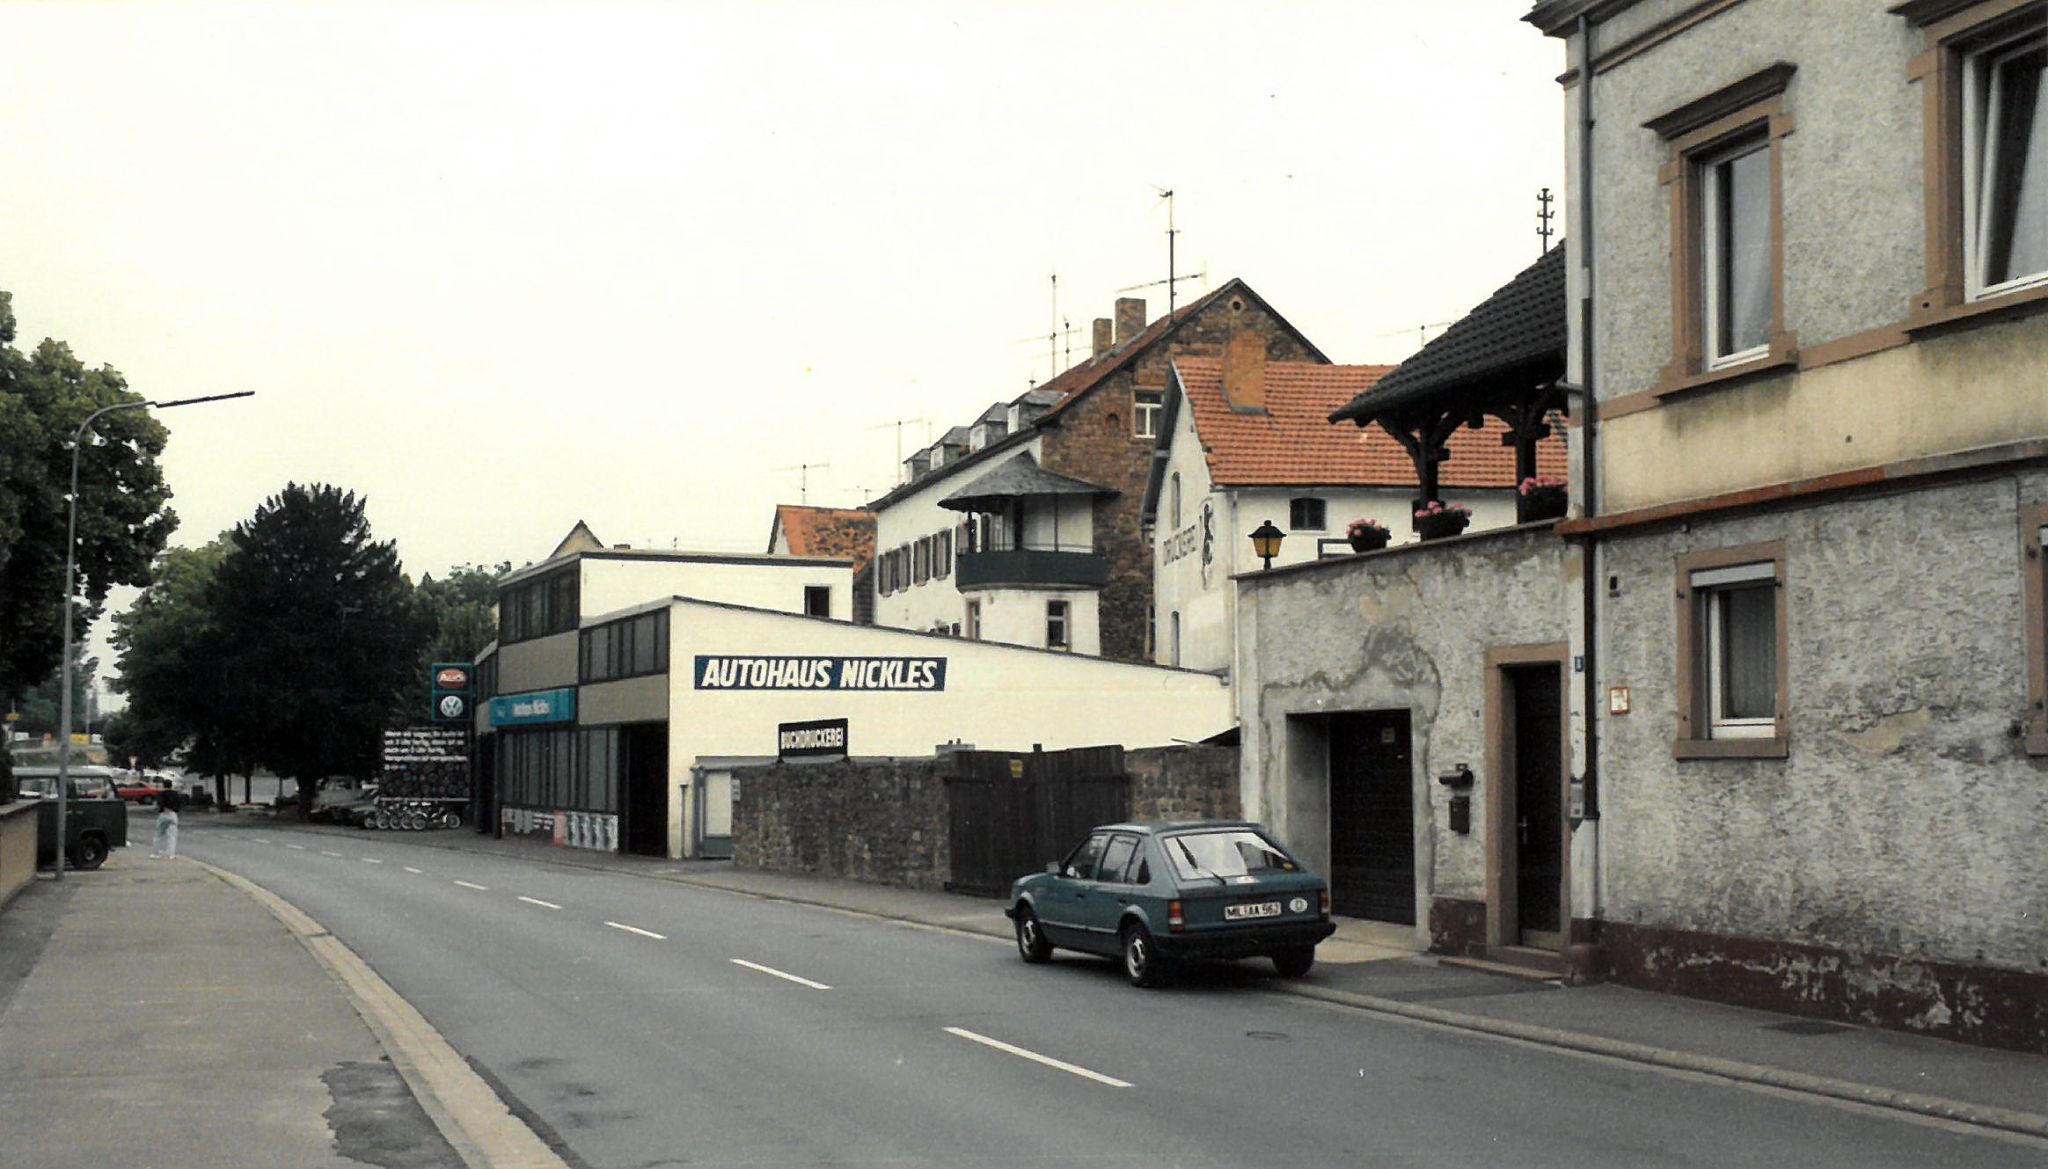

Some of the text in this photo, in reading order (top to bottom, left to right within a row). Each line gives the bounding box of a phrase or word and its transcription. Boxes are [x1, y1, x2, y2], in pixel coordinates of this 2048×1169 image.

[701, 659, 938, 688] AUTOHAUS NICKLES
[780, 728, 844, 750] BUCHDRUCKEREI
